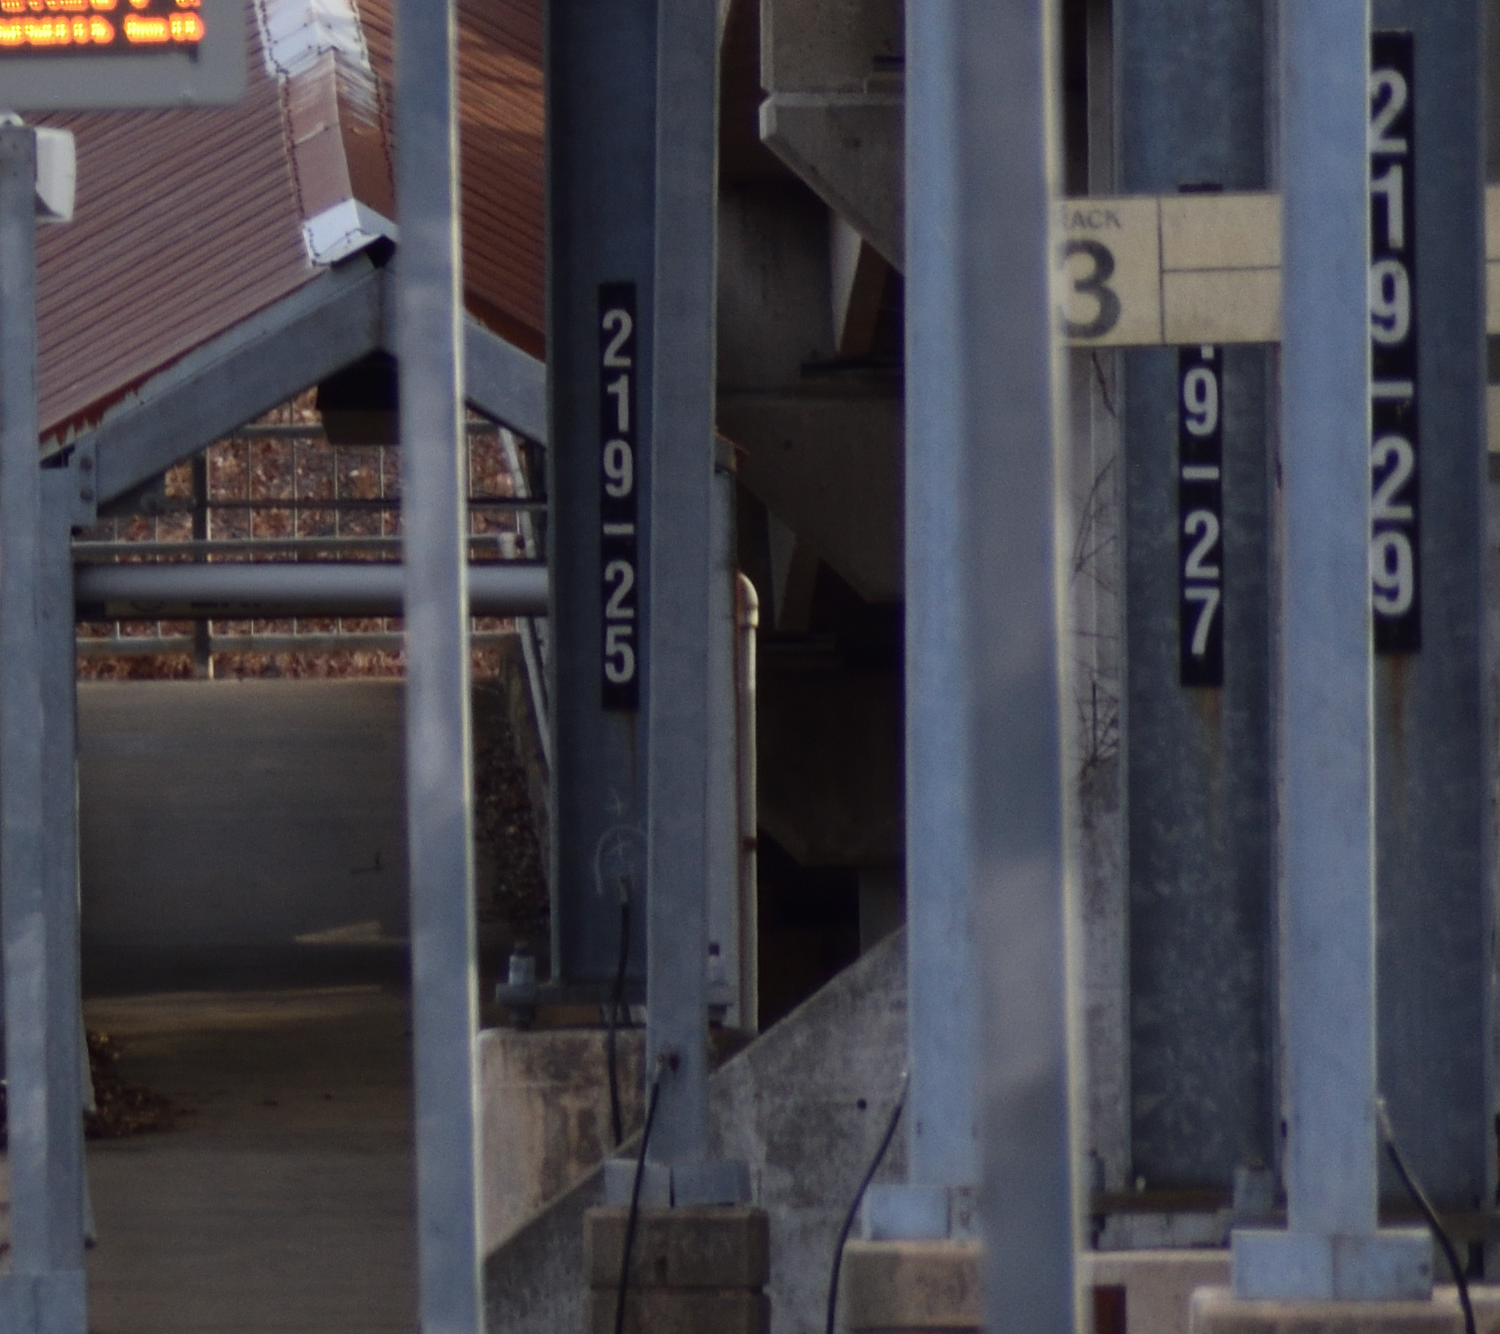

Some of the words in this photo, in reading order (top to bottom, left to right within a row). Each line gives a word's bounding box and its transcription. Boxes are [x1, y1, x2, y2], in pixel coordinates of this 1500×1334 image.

[1061, 238, 1122, 340] 3
[1062, 208, 1121, 229] ACK
[1370, 69, 1414, 617] 219-29
[601, 308, 636, 684] 219-25
[1181, 345, 1221, 658] 9-27
